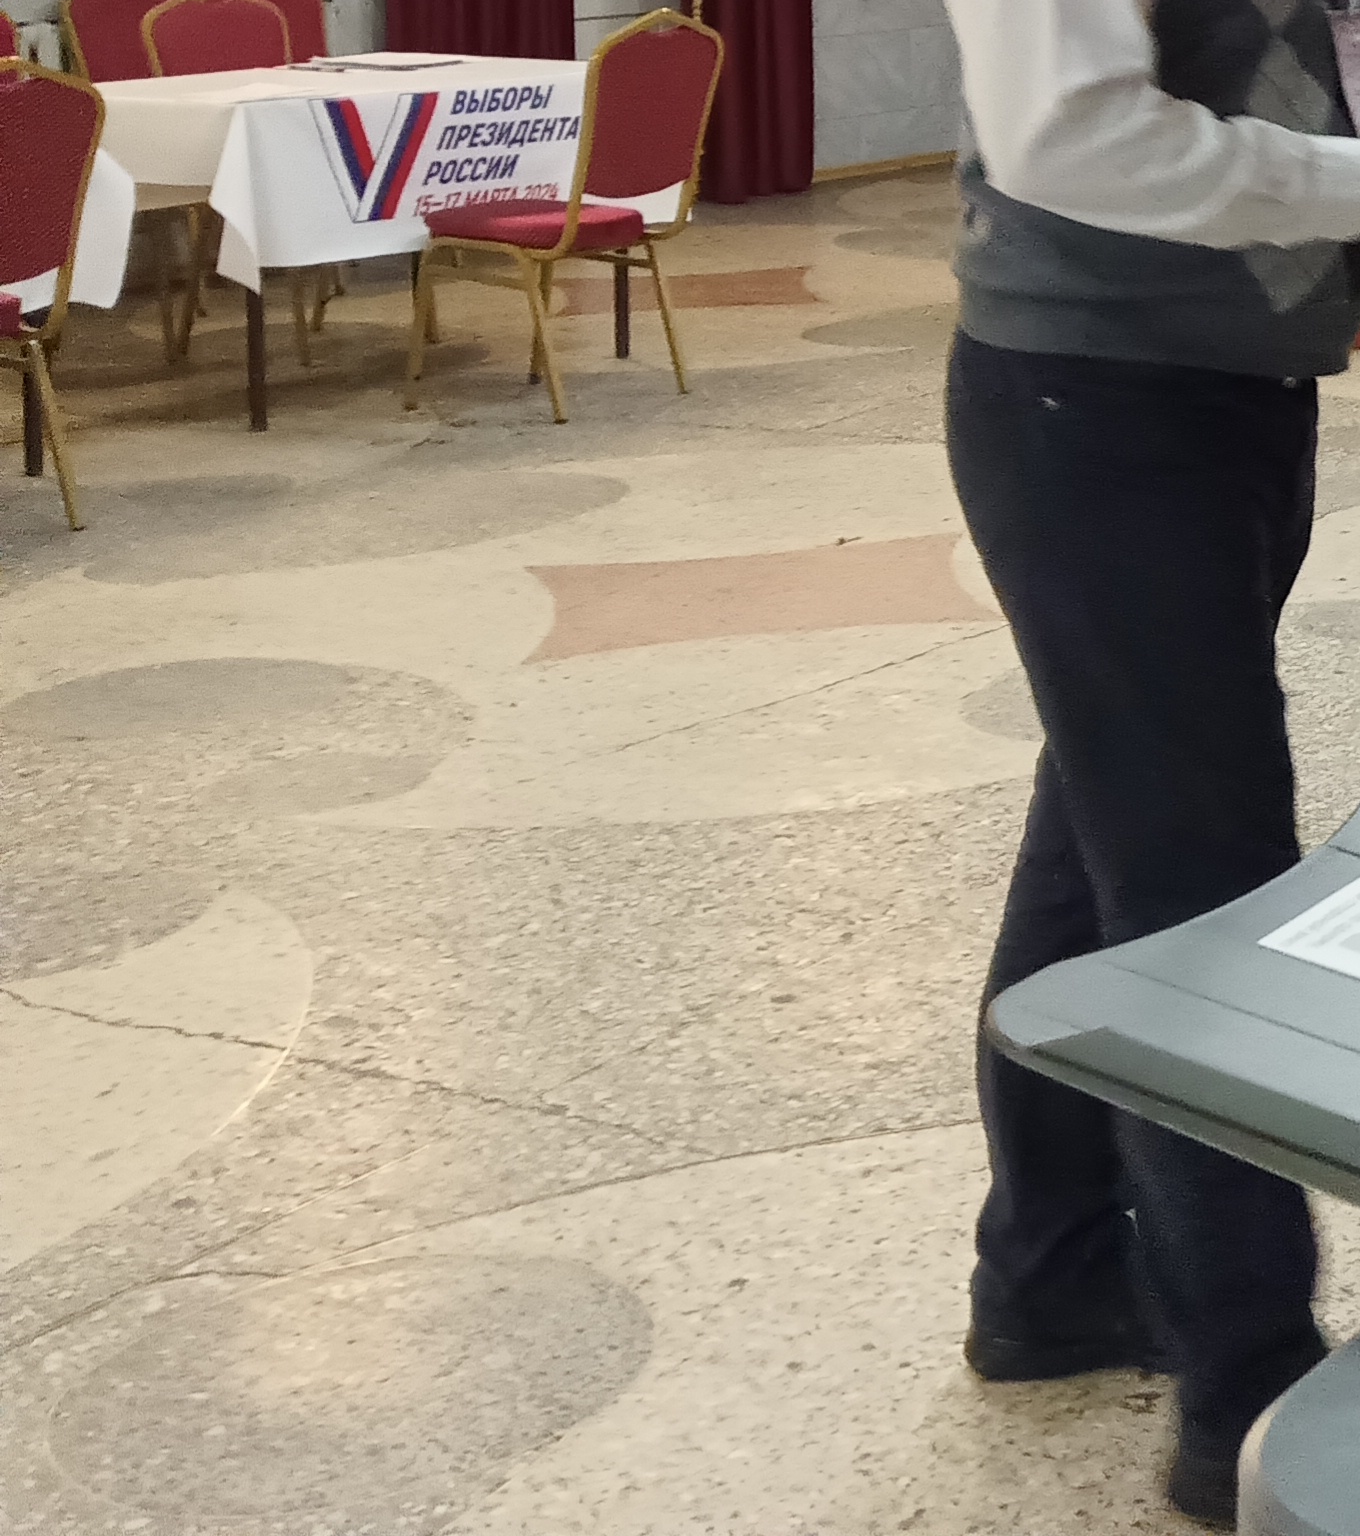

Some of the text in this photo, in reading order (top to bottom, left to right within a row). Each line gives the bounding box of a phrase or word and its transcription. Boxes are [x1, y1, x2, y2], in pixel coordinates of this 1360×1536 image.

[451, 84, 554, 115] ВЫБОРЫ
[436, 116, 580, 151] ПРЕЗИДЕНТА
[422, 154, 520, 186] РОССИИ
